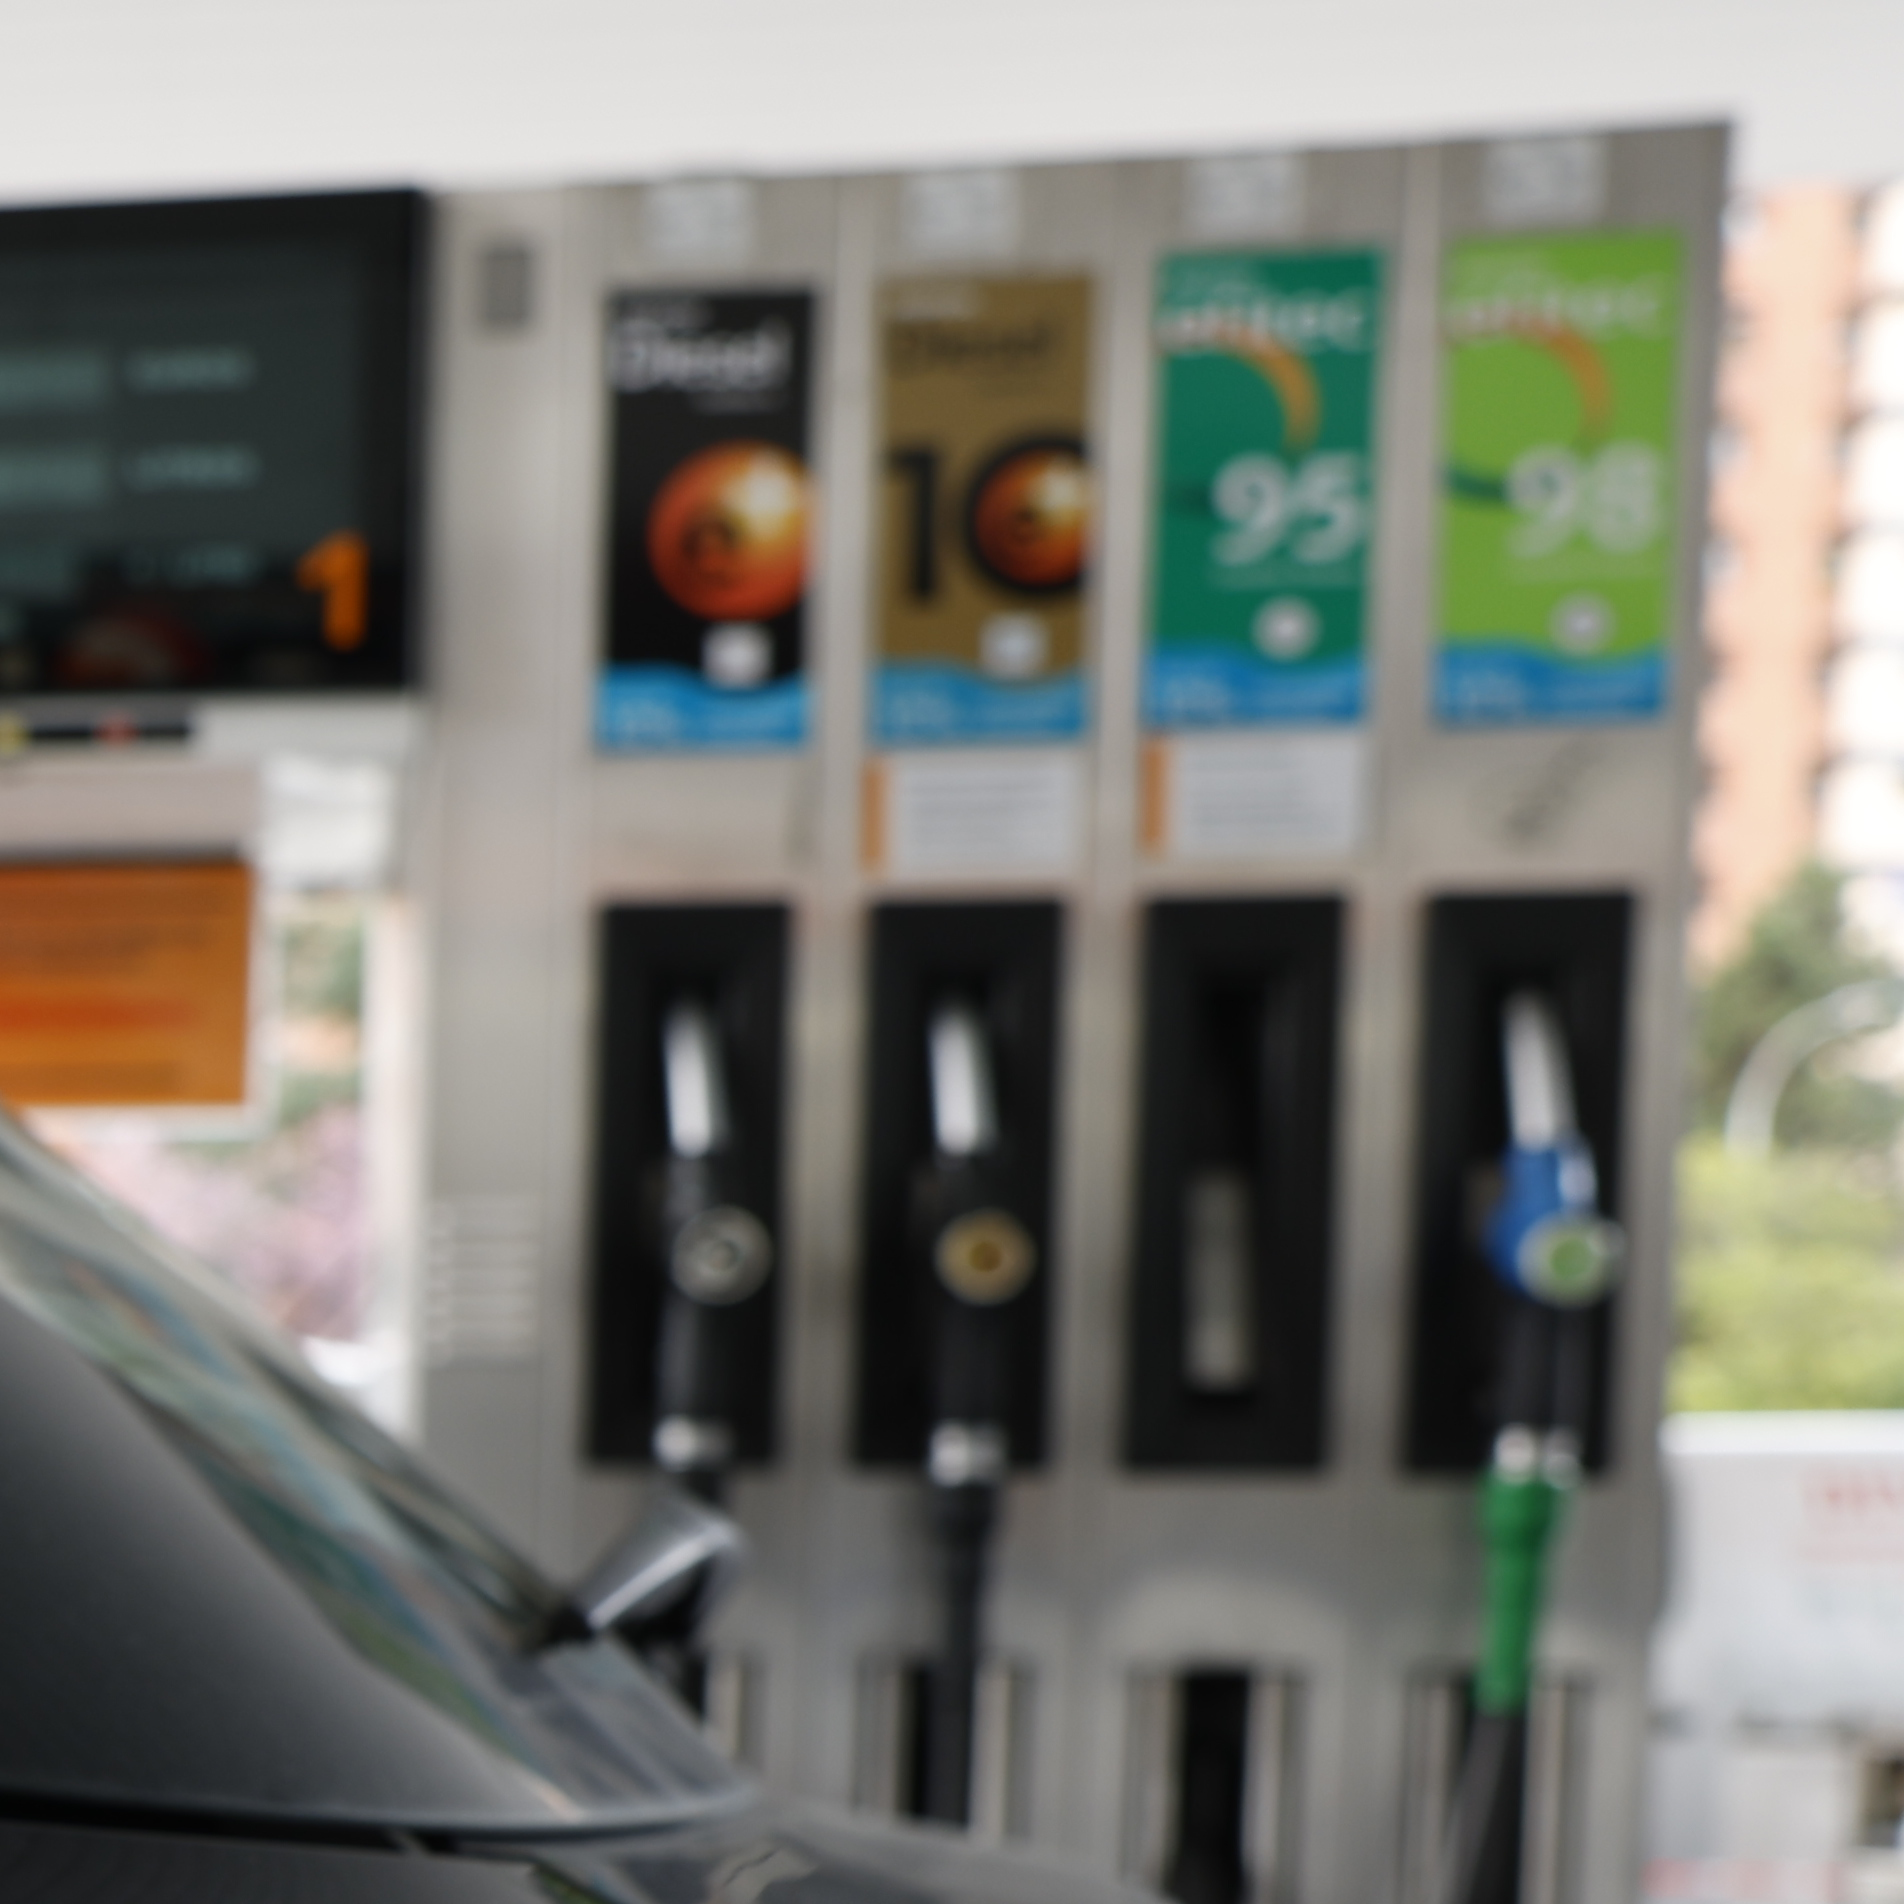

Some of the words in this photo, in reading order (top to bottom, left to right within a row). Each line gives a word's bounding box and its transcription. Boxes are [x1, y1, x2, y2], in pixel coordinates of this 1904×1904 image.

[1213, 449, 1368, 566] 95
[1505, 436, 1661, 560] 98
[295, 529, 369, 652] 1
